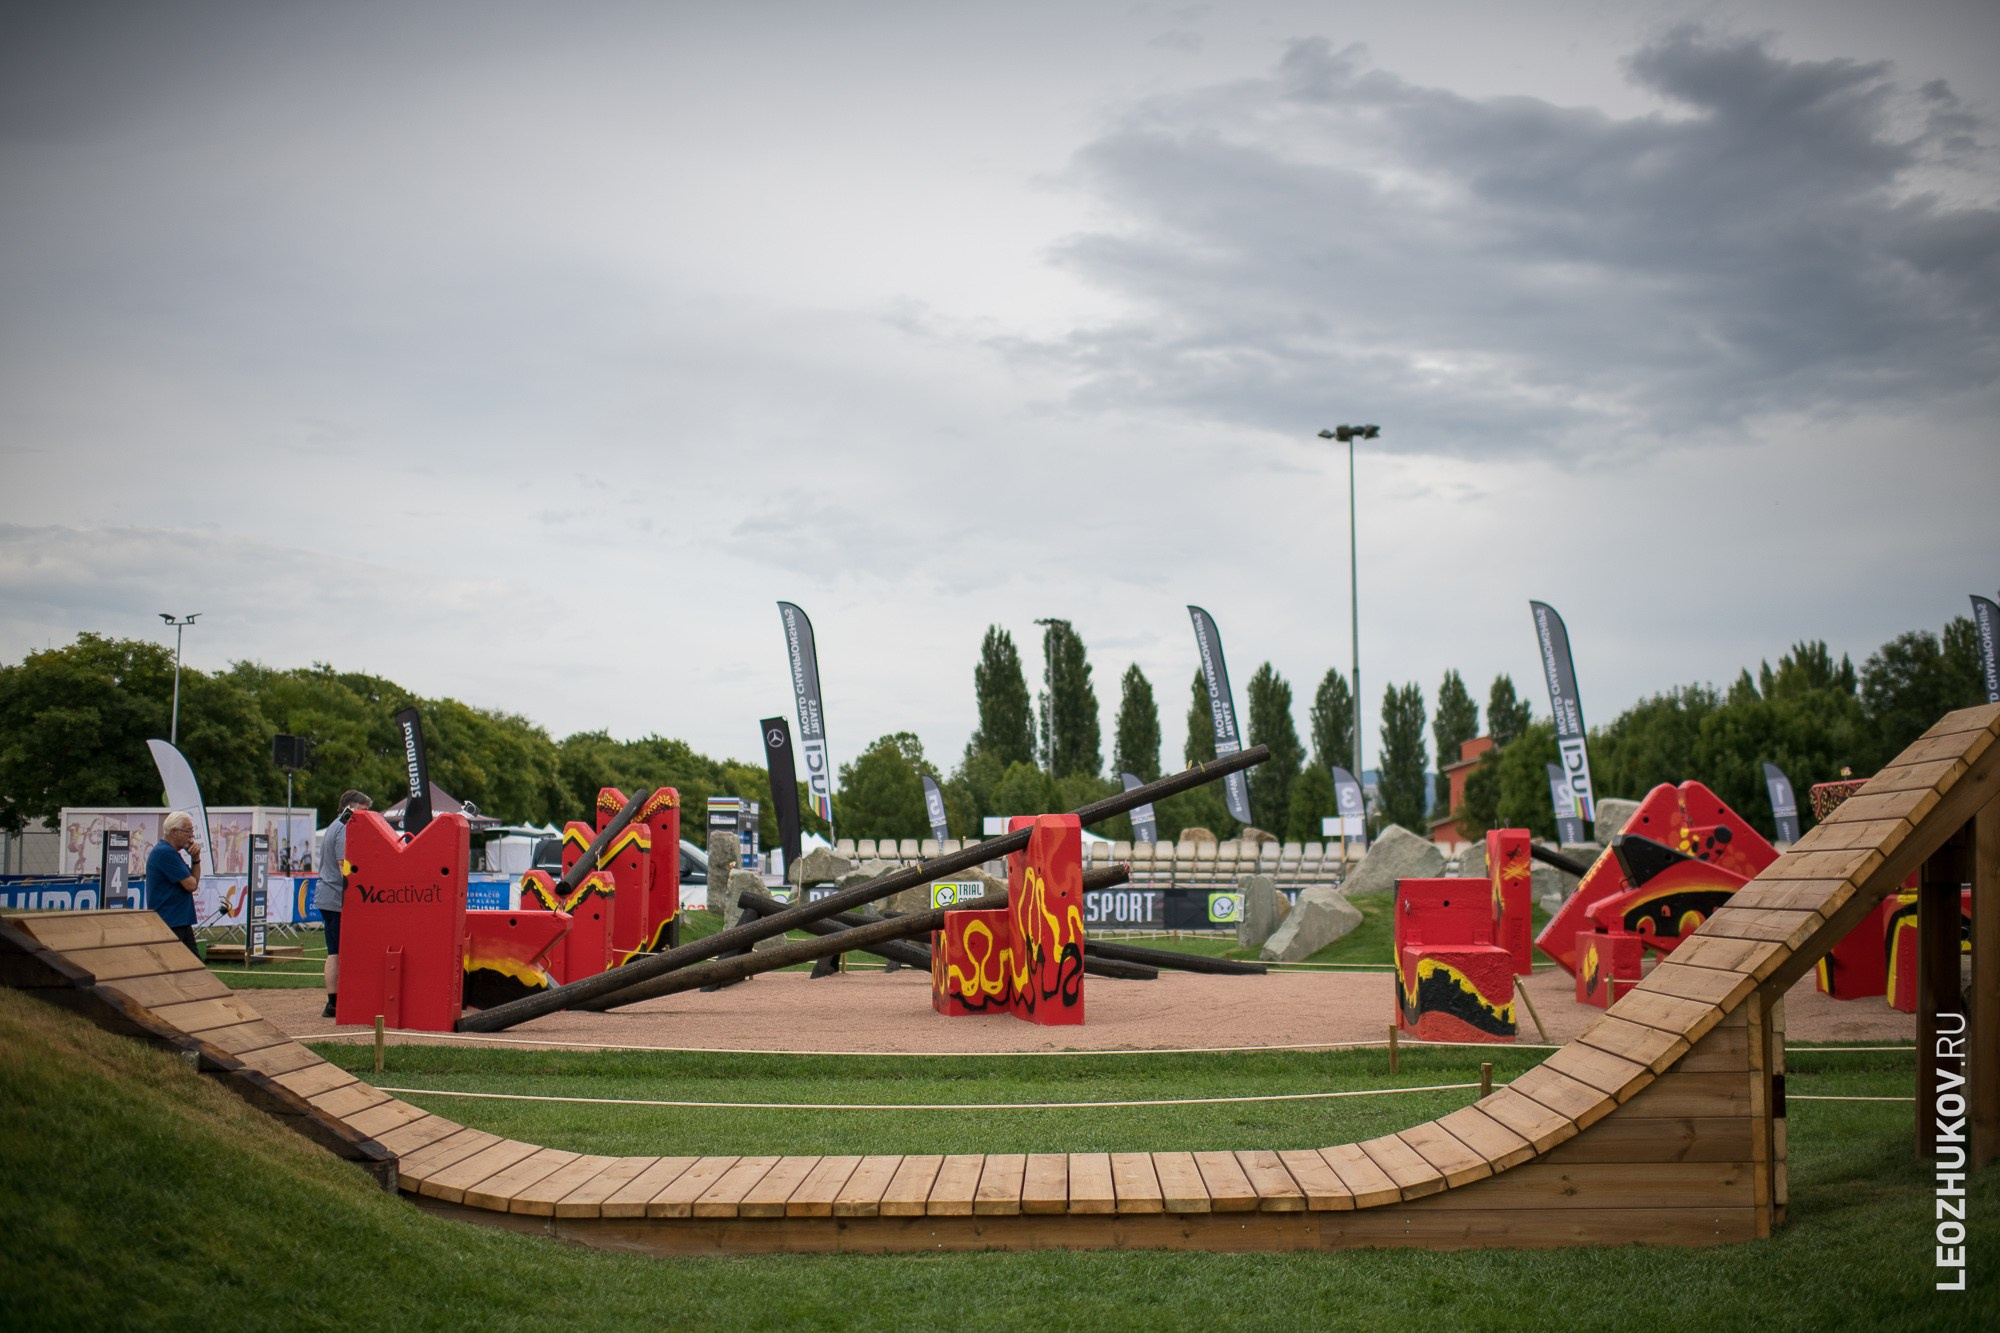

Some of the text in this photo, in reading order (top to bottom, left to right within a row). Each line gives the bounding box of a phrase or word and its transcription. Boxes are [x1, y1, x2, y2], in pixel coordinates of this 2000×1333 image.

[402, 721, 421, 798] sternmotor
[109, 853, 128, 864] FINISH
[254, 854, 268, 864] START
[111, 866, 122, 894] 4
[257, 865, 265, 889] 5
[958, 884, 982, 896] TRIAL
[1083, 893, 1156, 922] SPORT
